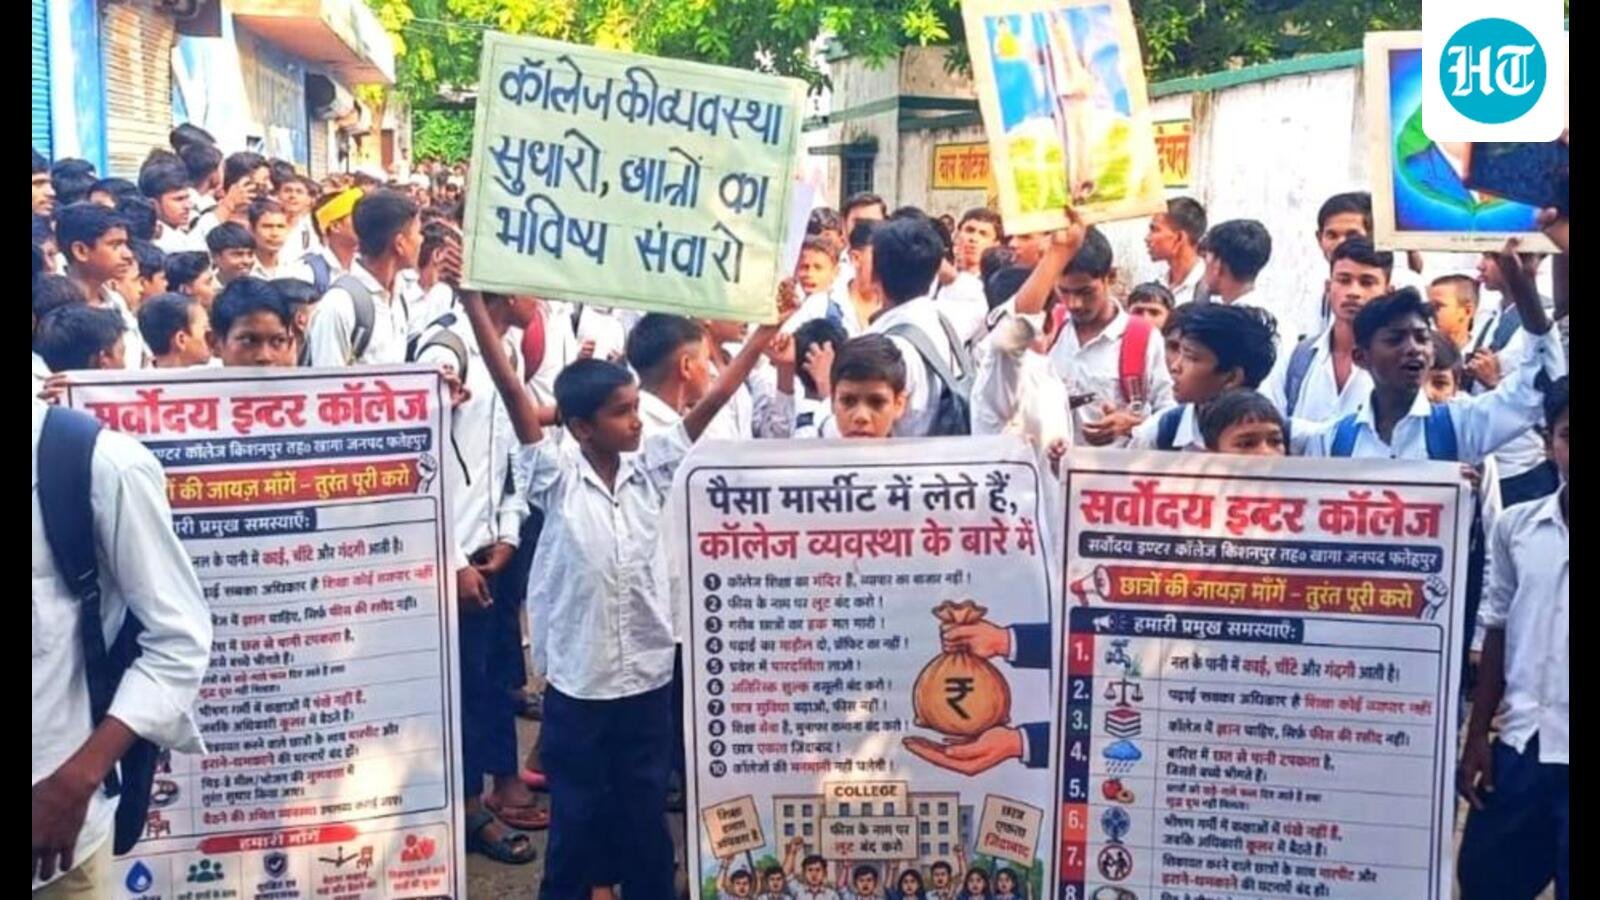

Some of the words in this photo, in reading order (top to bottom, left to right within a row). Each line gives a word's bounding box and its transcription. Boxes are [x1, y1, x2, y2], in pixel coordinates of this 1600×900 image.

[500, 55, 612, 121] कॉलेज
[489, 128, 608, 198] सुधारो,
[619, 146, 703, 208] छात्रों
[718, 172, 769, 218] का
[496, 193, 607, 265] भविष्य
[634, 221, 744, 283] संवारो
[86, 388, 220, 434] सर्वोदय
[230, 394, 307, 434] इन्टर
[317, 380, 430, 424] कॉलेज
[185, 442, 226, 460] कॉलेज
[230, 439, 284, 460] किशनपुर
[346, 436, 383, 451] जनपद
[179, 475, 204, 502] की
[315, 468, 349, 500] तुरंत
[352, 465, 379, 496] पूरी
[381, 463, 411, 488] करो
[706, 475, 771, 514] पैसा
[779, 473, 877, 513] मार्सीट
[885, 473, 912, 511] में
[921, 473, 977, 511] लेते
[985, 470, 1017, 515] हैं,
[1080, 481, 1215, 528] सर्वोदय
[1226, 496, 1307, 535] इन्टर
[1318, 490, 1444, 538] कॉलेज
[199, 518, 240, 537] प्रमुख
[698, 522, 799, 559] कॉलेज
[806, 529, 914, 559] व्यवस्था
[921, 518, 952, 556] के
[960, 516, 1008, 555] बारे
[1015, 517, 1035, 556] में
[1088, 537, 1133, 554] सर्वोदय
[1137, 542, 1170, 556] इण्टर
[1175, 541, 1216, 558] कॉलेज
[1221, 541, 1276, 565] किशनपुर
[1346, 551, 1385, 565] जनपद
[1389, 548, 1435, 571] फतेहपुर
[1120, 571, 1161, 598] छात्रों
[1164, 573, 1189, 598] की
[1306, 580, 1344, 612] तुरंत
[1345, 581, 1374, 612] पूरी
[1378, 583, 1414, 608] करो
[1133, 615, 1177, 633] हमारी
[1182, 619, 1221, 638] प्रमुख
[1074, 642, 1089, 661] 1.
[1171, 655, 1189, 671] नल
[1192, 653, 1203, 670] के
[1205, 654, 1228, 671] पानी
[1230, 654, 1240, 672] में
[1301, 658, 1321, 678] और
[1324, 660, 1356, 679] गंदगी
[1359, 662, 1384, 681] आती
[1073, 680, 1089, 699] 2.
[1073, 711, 1088, 729] 3.
[1070, 742, 1087, 761] 4.
[834, 786, 897, 797] COLLEGE
[1070, 780, 1085, 798] 5.
[829, 822, 854, 836] फीस
[858, 823, 869, 835] के
[872, 825, 892, 837] नाम
[895, 824, 910, 836] पर
[1069, 811, 1084, 829] 6.
[1067, 847, 1082, 866] 7.
